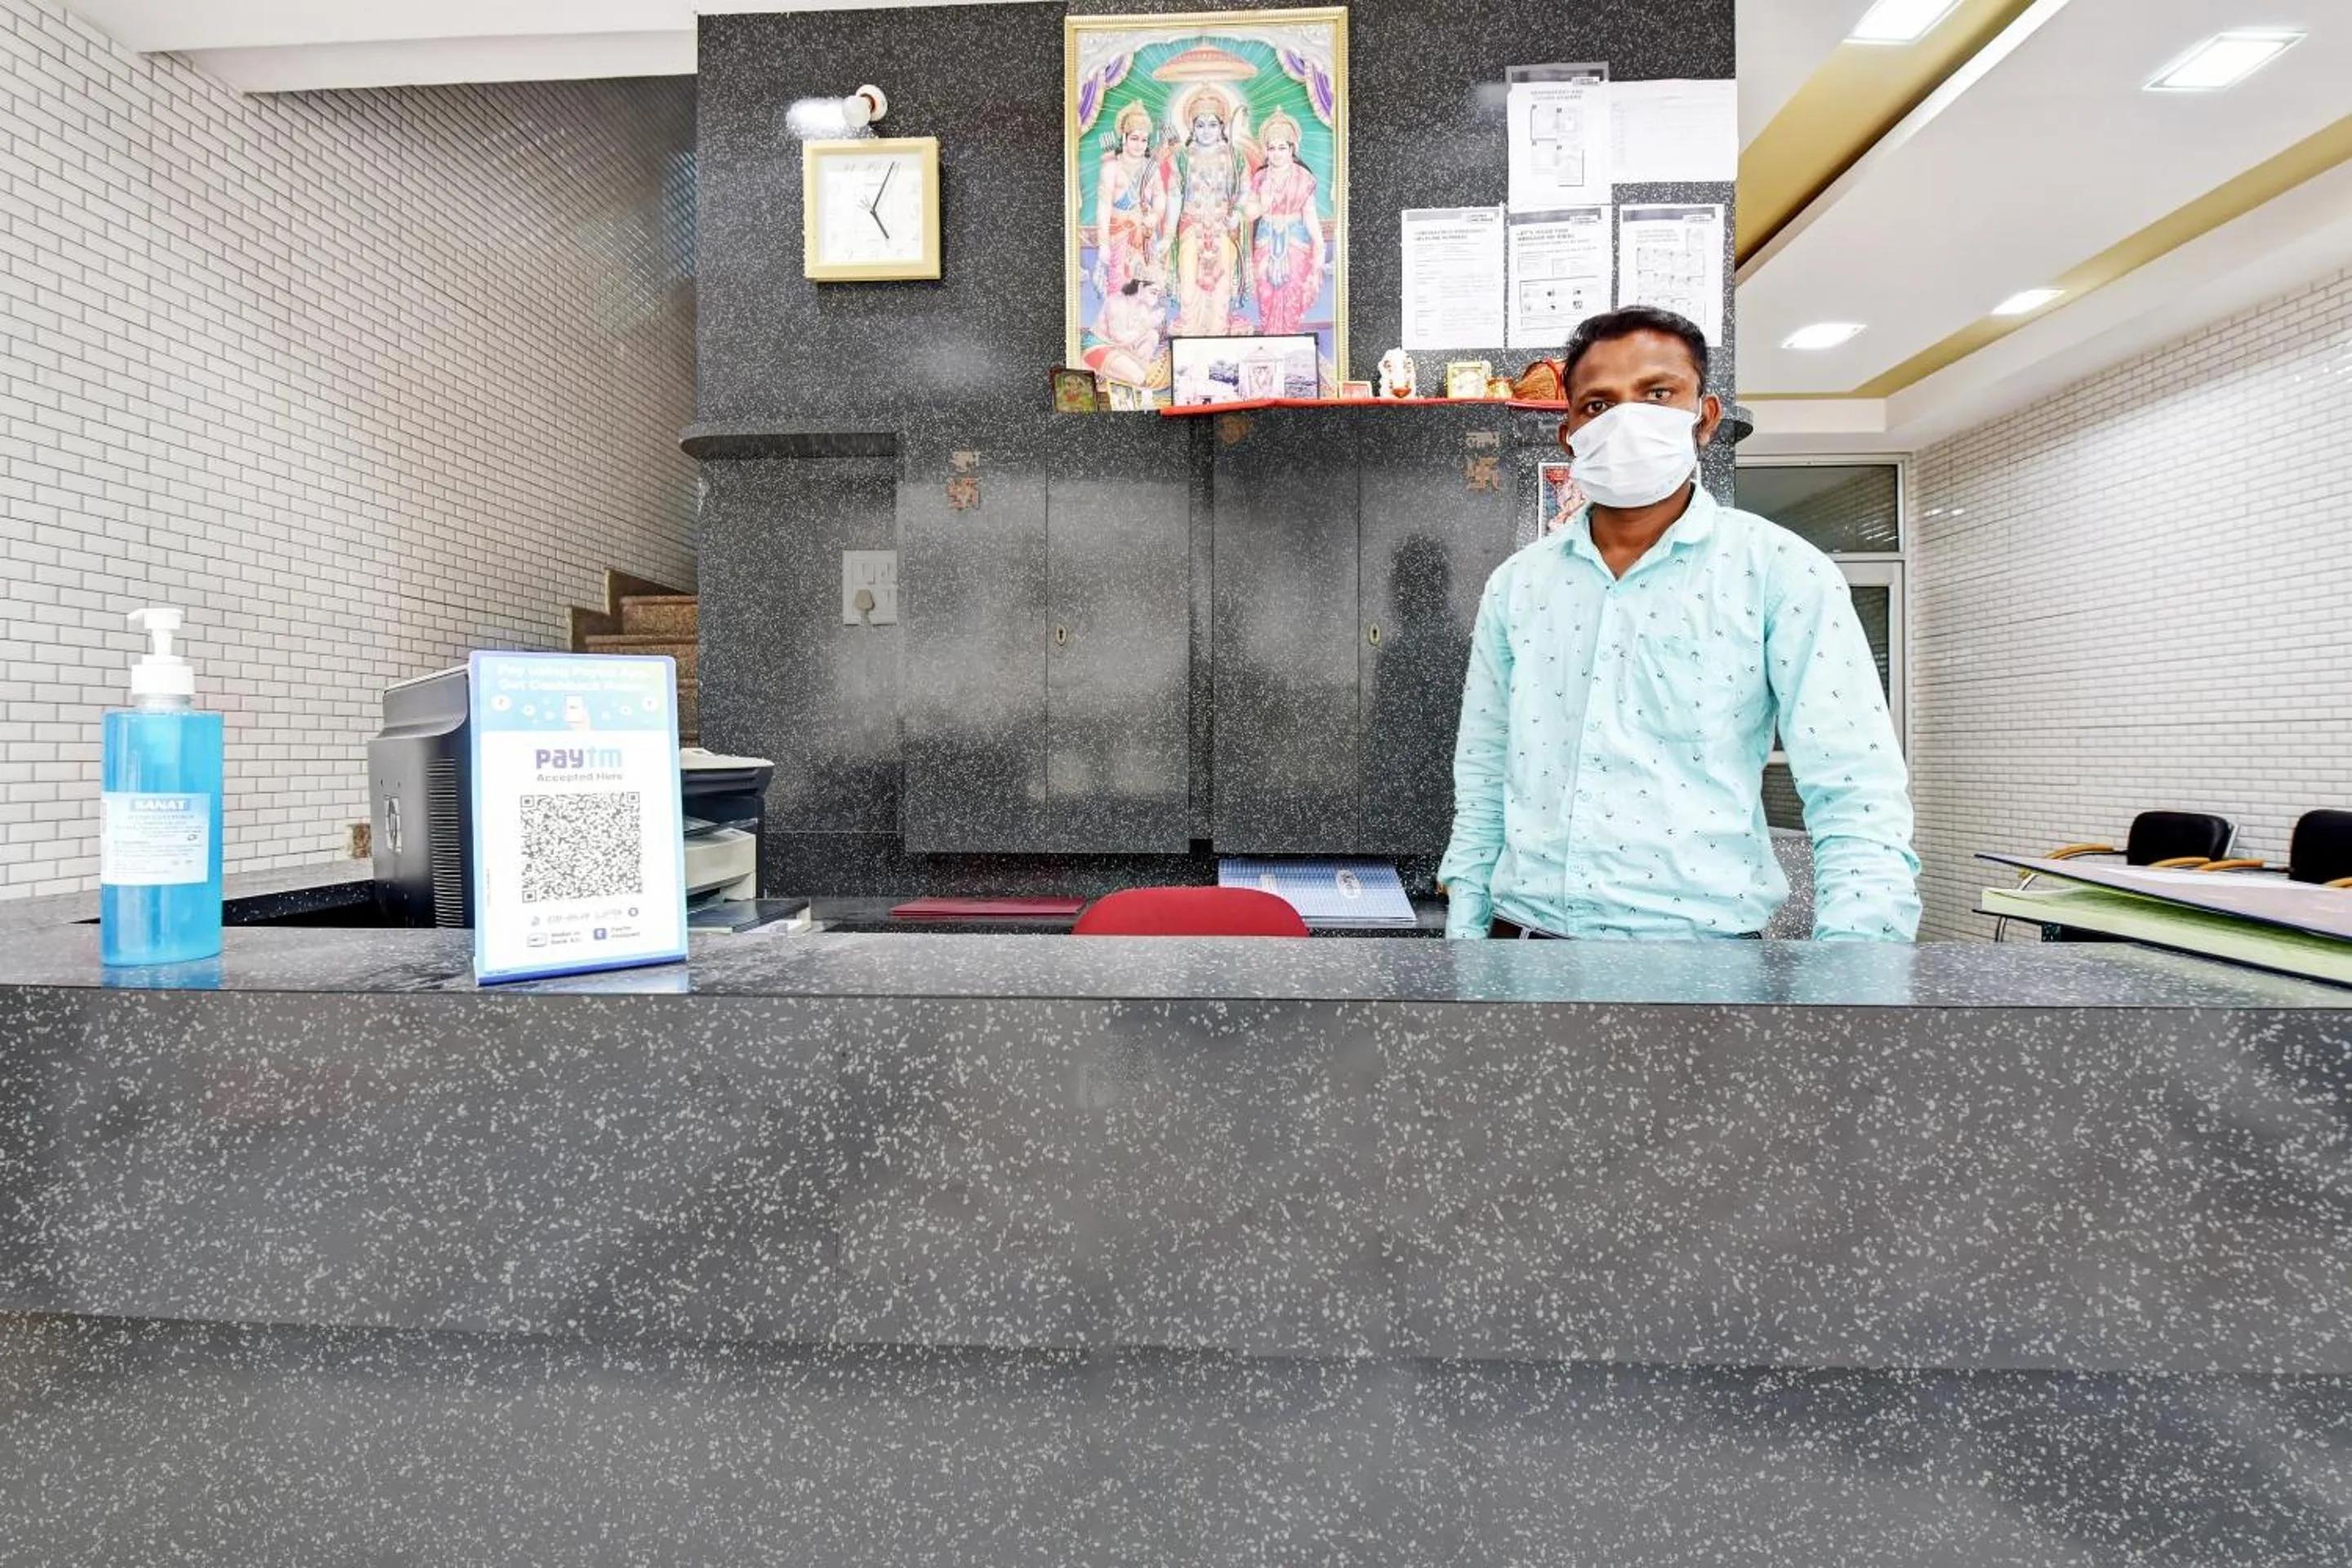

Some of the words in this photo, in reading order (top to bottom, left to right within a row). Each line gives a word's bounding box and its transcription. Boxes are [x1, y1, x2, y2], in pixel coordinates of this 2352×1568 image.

[537, 772, 594, 782] Accepted
[596, 771, 623, 781] Here
[134, 800, 187, 810] SANAT
